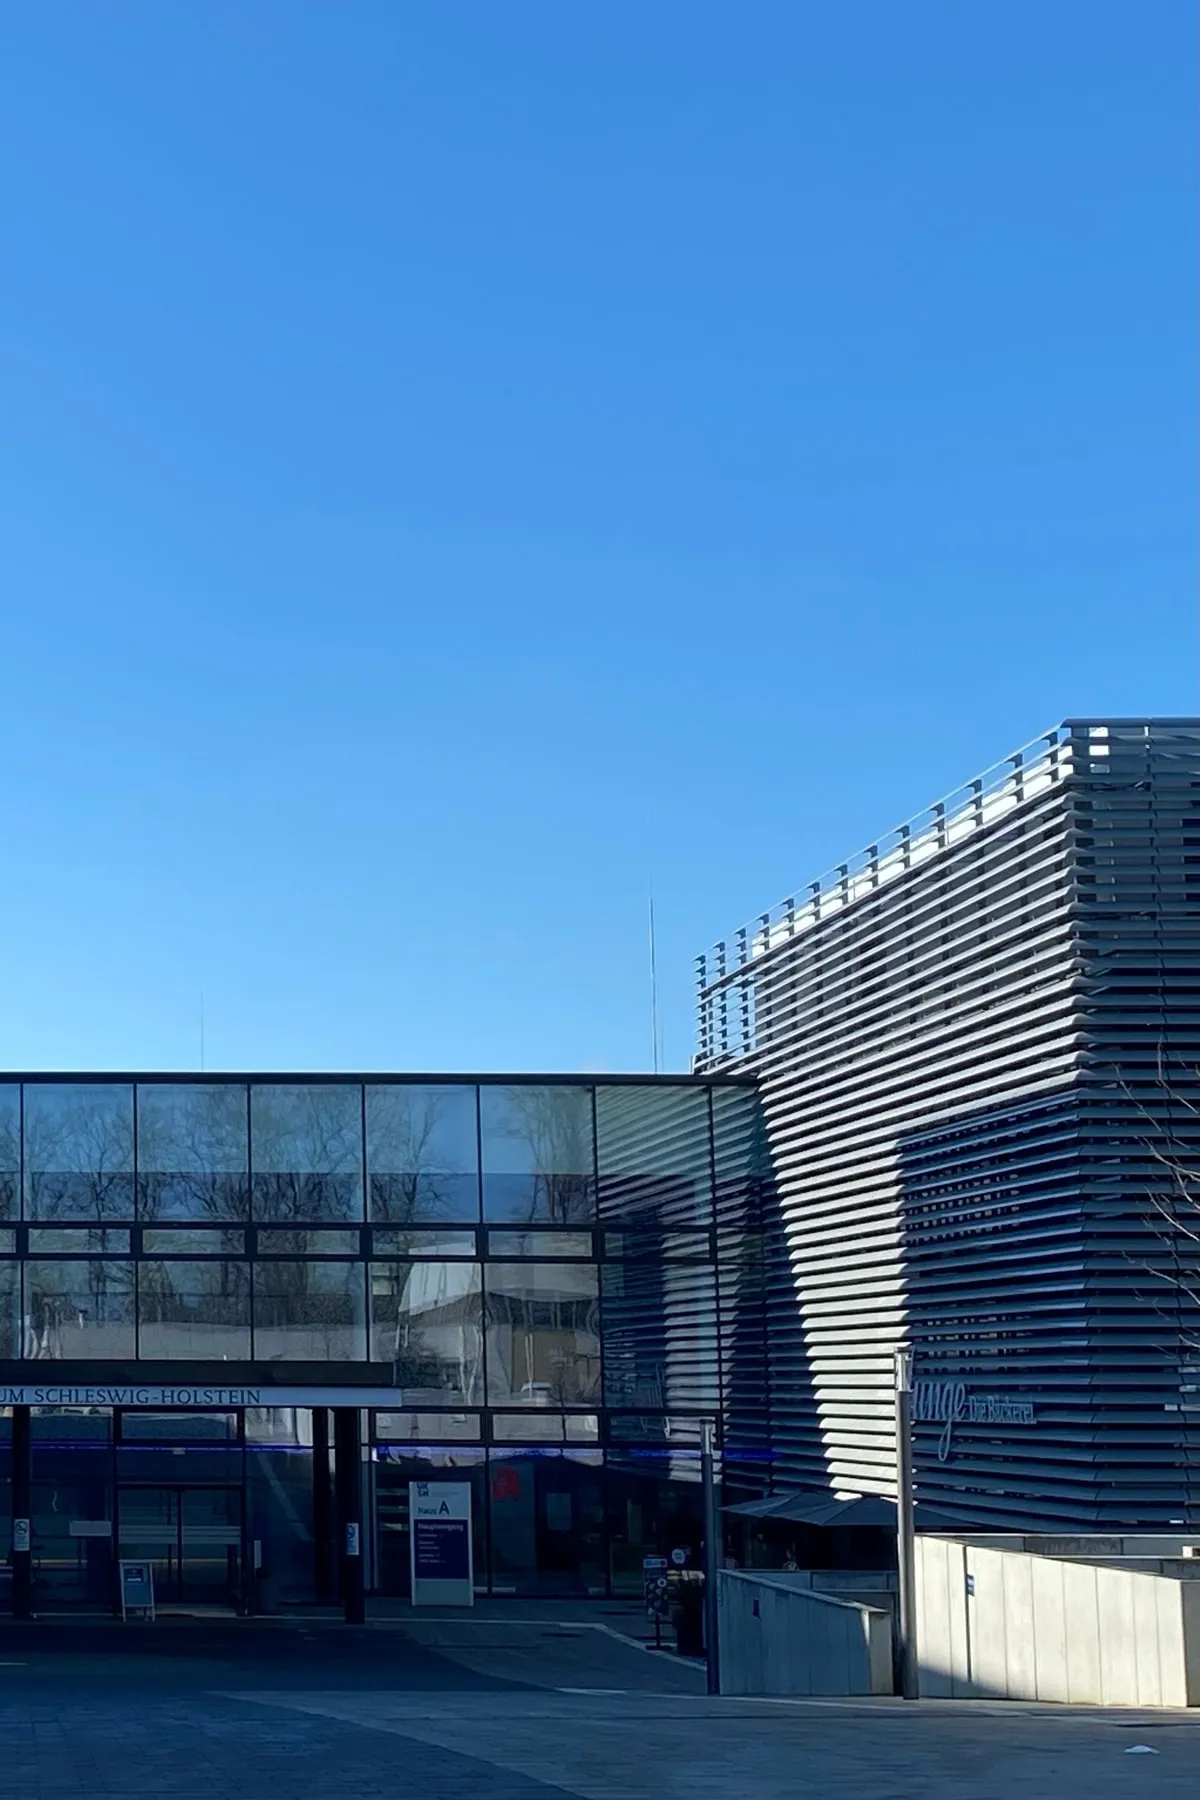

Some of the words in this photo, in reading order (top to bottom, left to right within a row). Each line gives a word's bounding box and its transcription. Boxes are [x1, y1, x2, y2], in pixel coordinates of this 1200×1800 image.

[34, 1388, 261, 1405] SCHLESWIG-HOLSTEIN
[912, 1380, 967, 1461] unge
[439, 1500, 450, 1515] A
